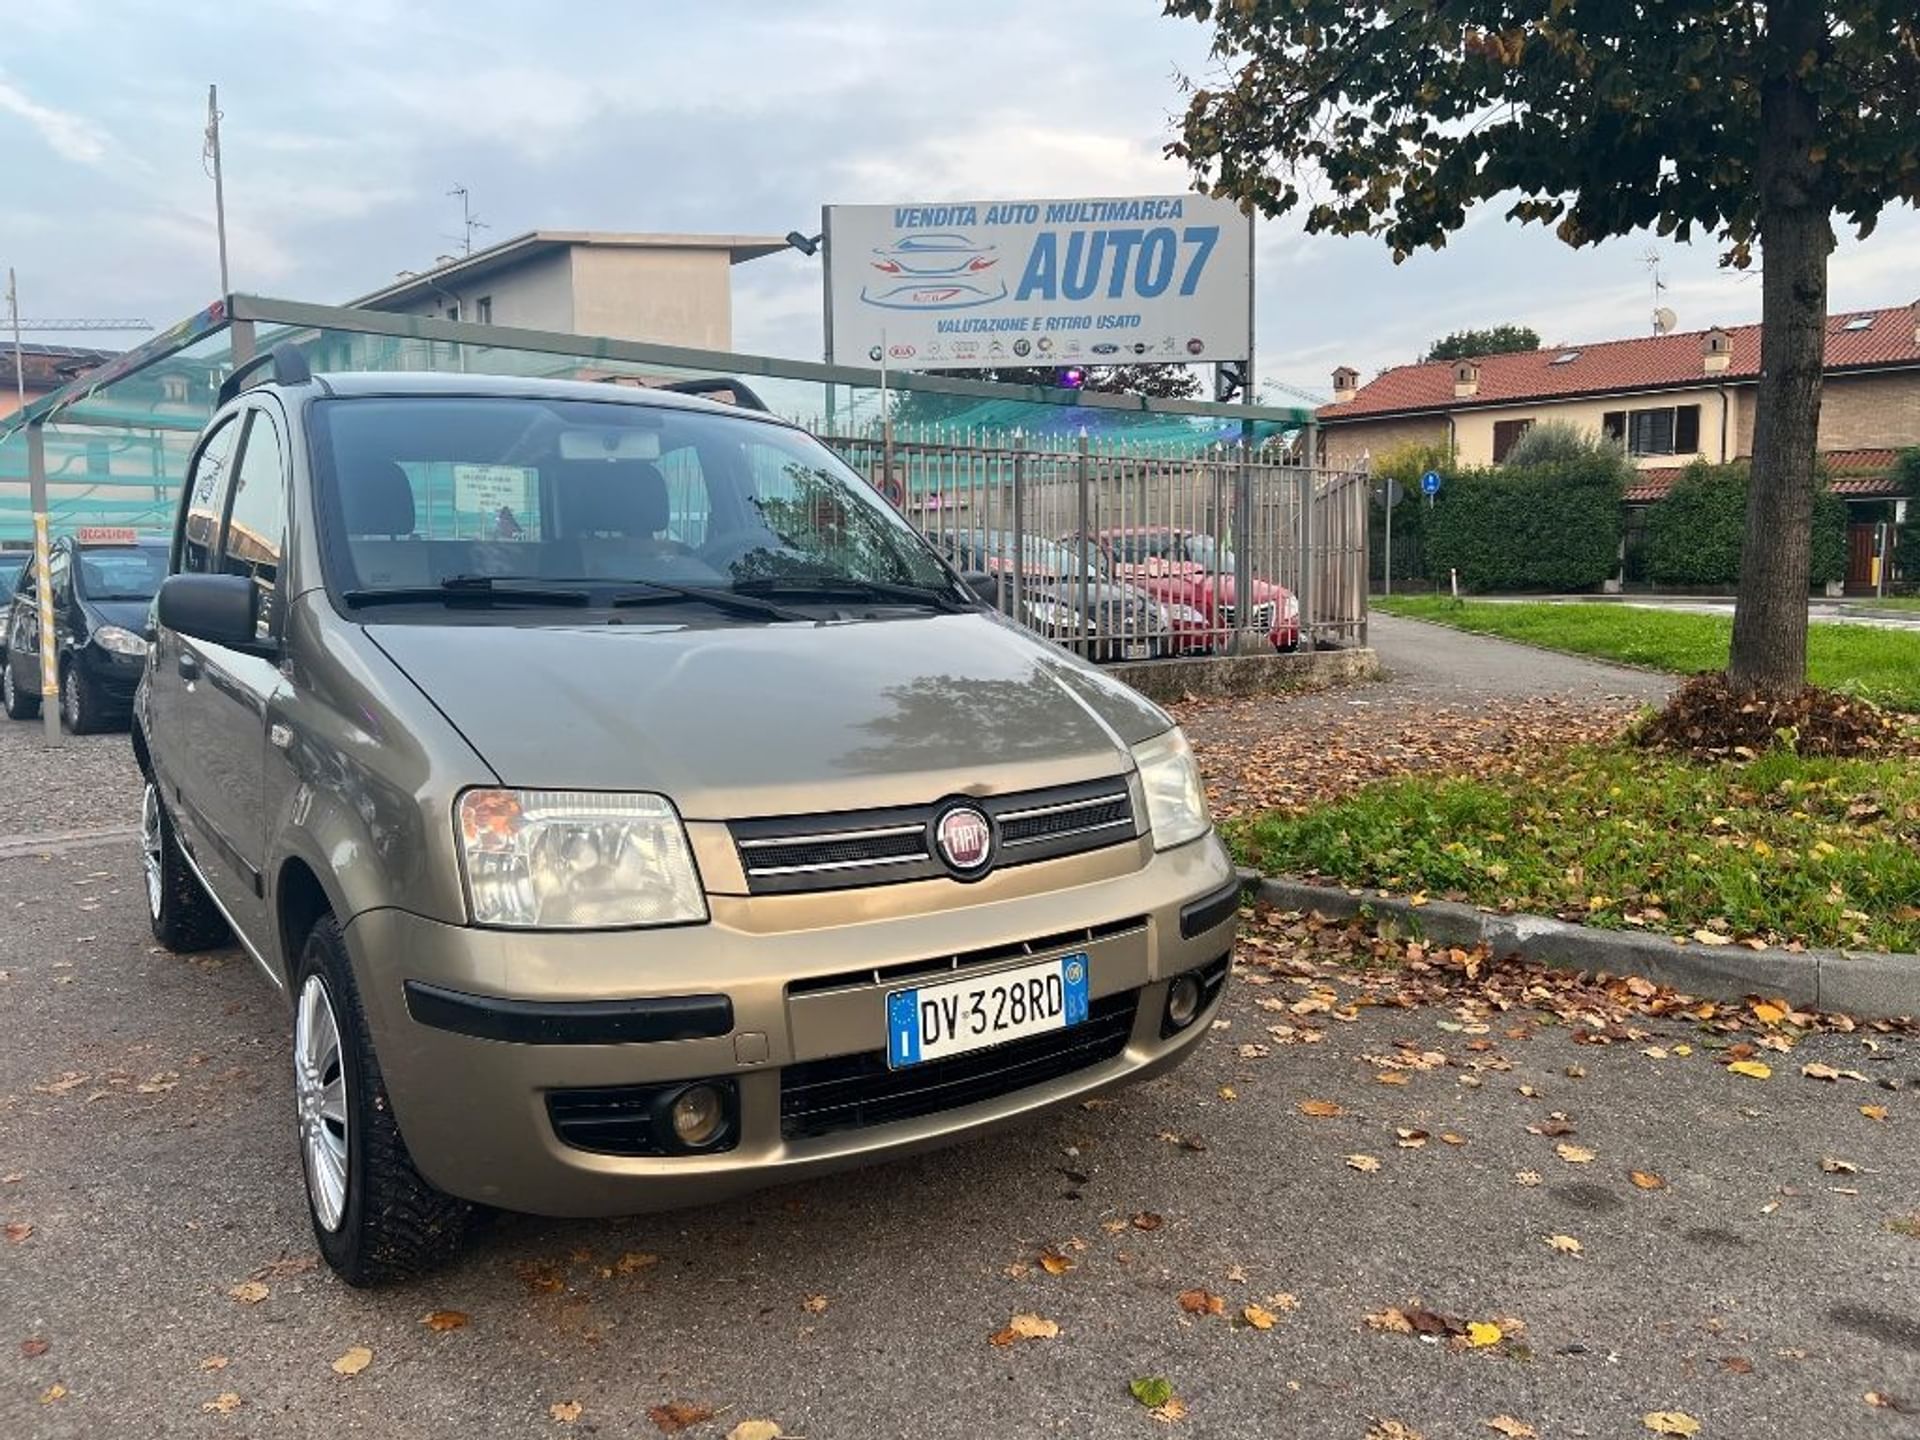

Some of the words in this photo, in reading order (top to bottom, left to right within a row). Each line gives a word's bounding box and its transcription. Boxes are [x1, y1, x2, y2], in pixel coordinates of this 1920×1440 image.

[894, 206, 977, 228] VENDITA
[984, 204, 1040, 224] AUTO
[1045, 199, 1184, 223] MULTIMARCA
[1014, 226, 1220, 301] AUTO7
[937, 317, 1030, 333] VALUTAZIONE
[1032, 316, 1043, 331] E
[1046, 315, 1092, 330] RITIRO
[1097, 314, 1141, 329] USATO
[922, 995, 958, 1046] DV
[969, 973, 1063, 1035] 328RD
